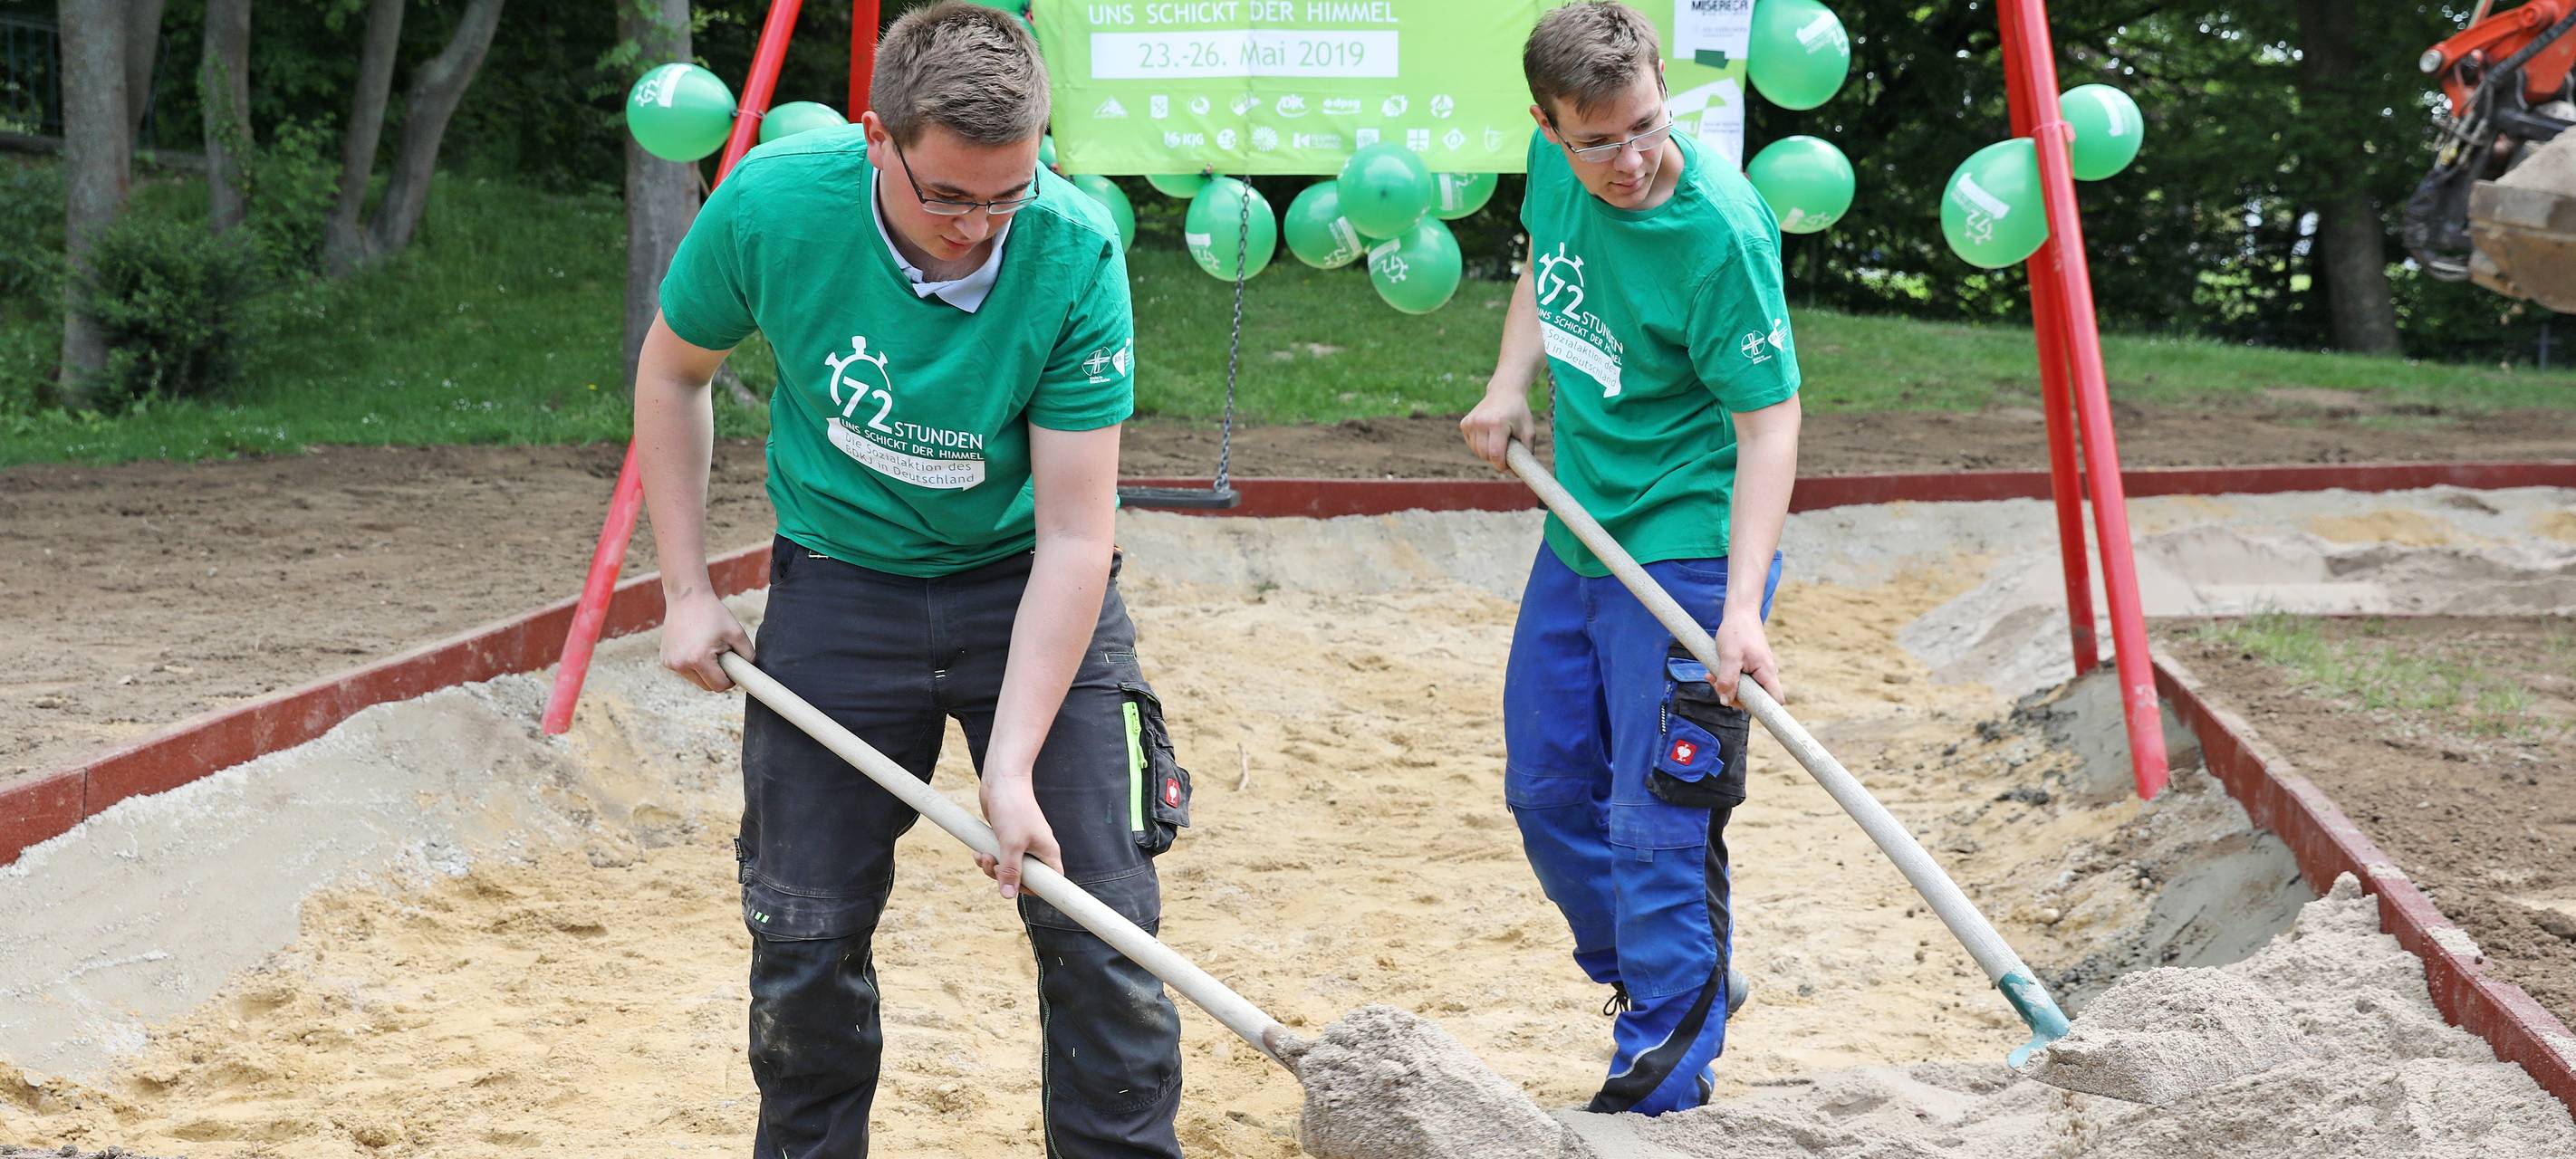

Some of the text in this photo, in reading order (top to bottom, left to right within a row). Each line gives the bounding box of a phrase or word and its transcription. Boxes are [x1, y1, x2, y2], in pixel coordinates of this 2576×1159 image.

[1089, 0, 1399, 25] UNS SCHICKT DER HIMMEL
[1138, 41, 1365, 68] 23.-26. Mai 2019
[1540, 273, 1584, 321] 72
[1553, 315, 1589, 338] SCHICKT
[1590, 332, 1603, 348] DER
[841, 376, 983, 450] 72 STUNDEN
[841, 418, 985, 460] UNS SCHICKT DER HIMMEL
[866, 444, 942, 472] Sozialaktion
[947, 463, 972, 472] des
[878, 462, 889, 472] in
[893, 465, 975, 485] Deutschland
